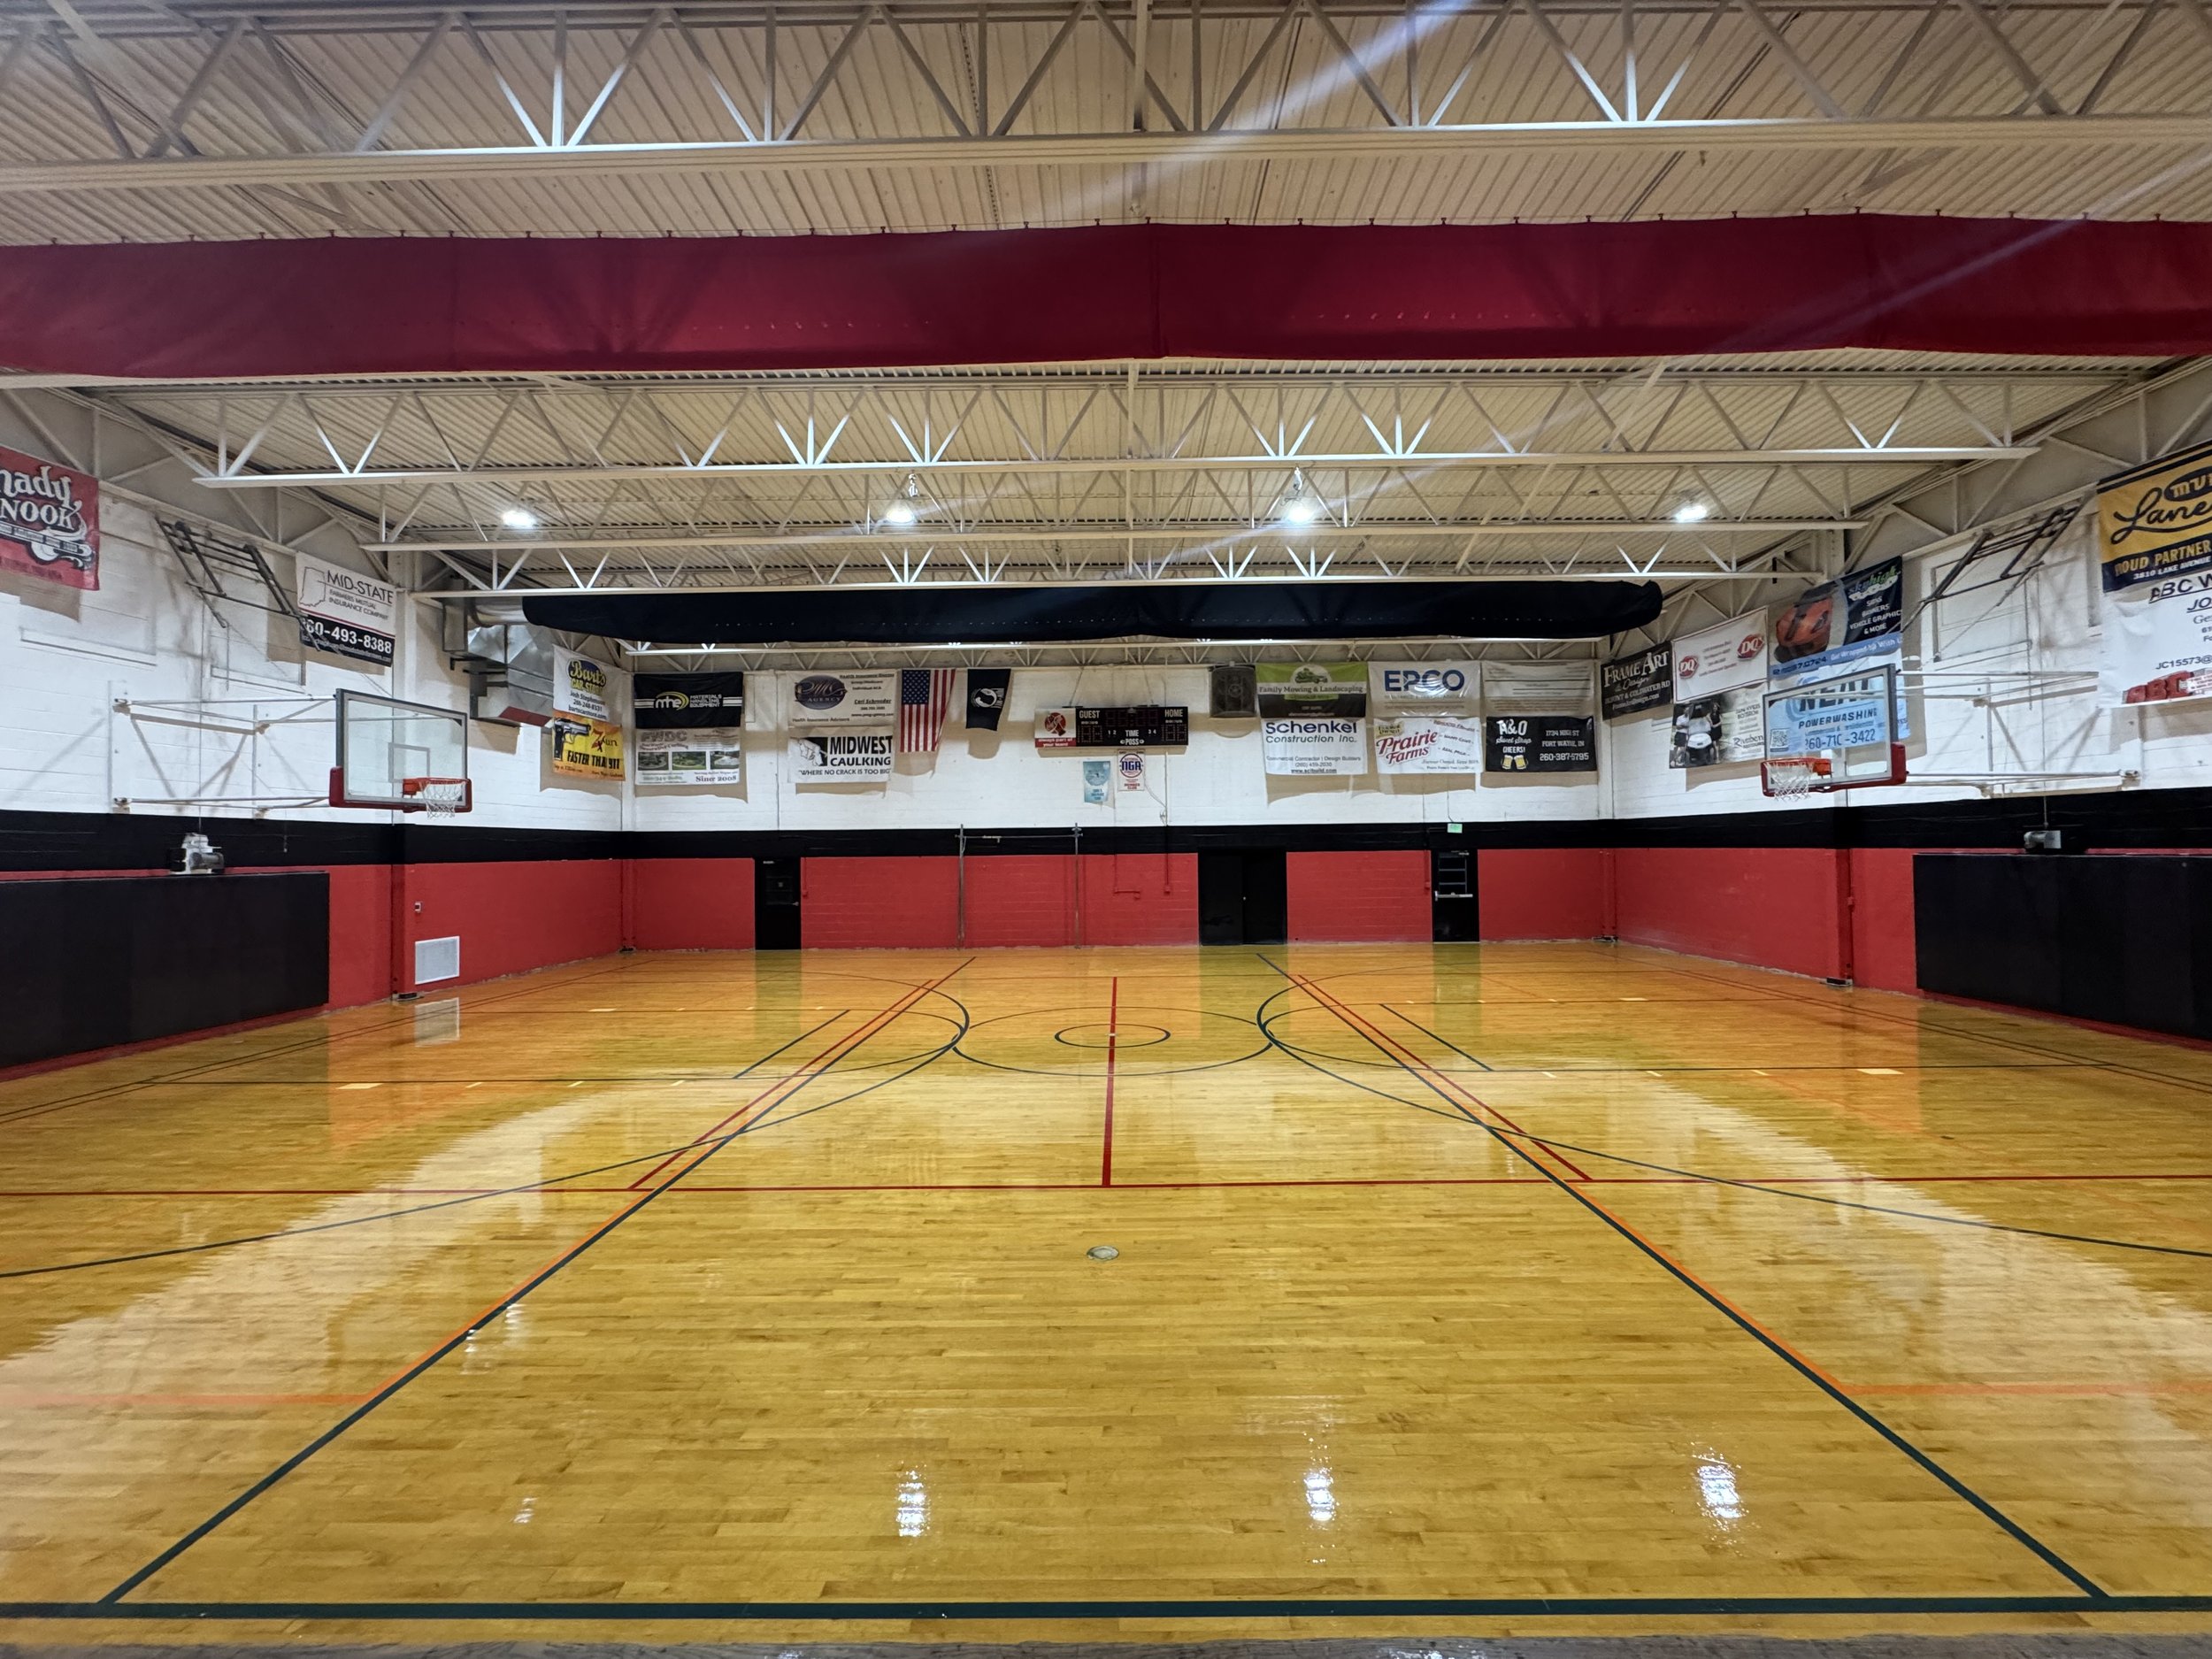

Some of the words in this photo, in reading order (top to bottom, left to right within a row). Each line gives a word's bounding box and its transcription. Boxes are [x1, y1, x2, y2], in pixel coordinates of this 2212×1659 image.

[2154, 540, 2211, 566] PARTNER
[327, 570, 394, 603] MID-STATE
[2149, 579, 2193, 602] ABC
[328, 597, 362, 613] INSURANCE
[1741, 639, 1759, 655] DQ
[1603, 662, 1641, 687] FRAME
[1641, 650, 1669, 676] ART
[1680, 658, 1695, 672] DQ
[1384, 669, 1464, 692] EPCO
[1284, 686, 1312, 695] Mowing
[1319, 685, 1363, 694] Landscaping
[1164, 709, 1183, 718] HOME
[1265, 720, 1357, 734] Schenkel
[830, 735, 893, 755] MIDWEST
[1265, 734, 1334, 744] Construction
[1339, 734, 1357, 743] Inc.
[1376, 729, 1438, 755] Prairie
[567, 750, 589, 765] FASTER
[830, 757, 891, 767] CAULKING
[1386, 746, 1429, 764] Farms
